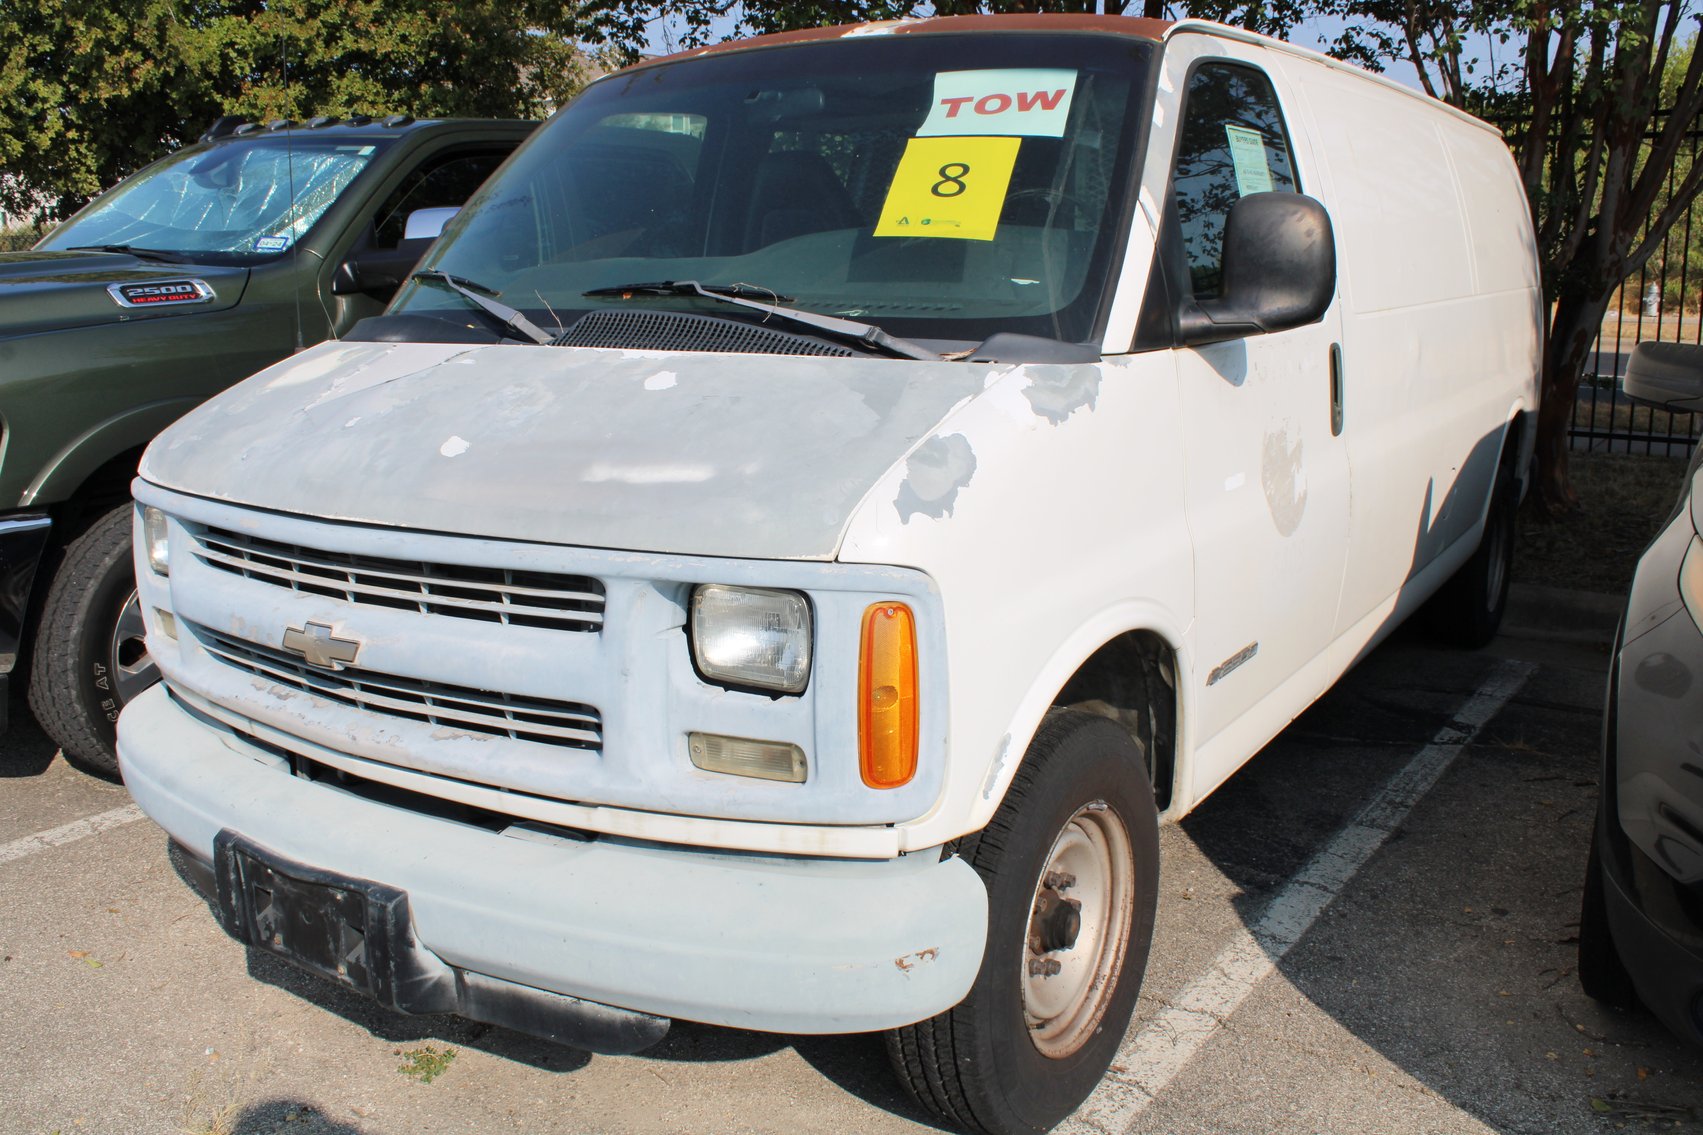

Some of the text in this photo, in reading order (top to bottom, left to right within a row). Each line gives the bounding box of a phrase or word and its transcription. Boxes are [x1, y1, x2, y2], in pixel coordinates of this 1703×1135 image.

[940, 88, 1067, 118] TOW
[930, 162, 970, 198] 8
[127, 285, 193, 297] 2500
[132, 293, 197, 303] HEAVY DUTY
